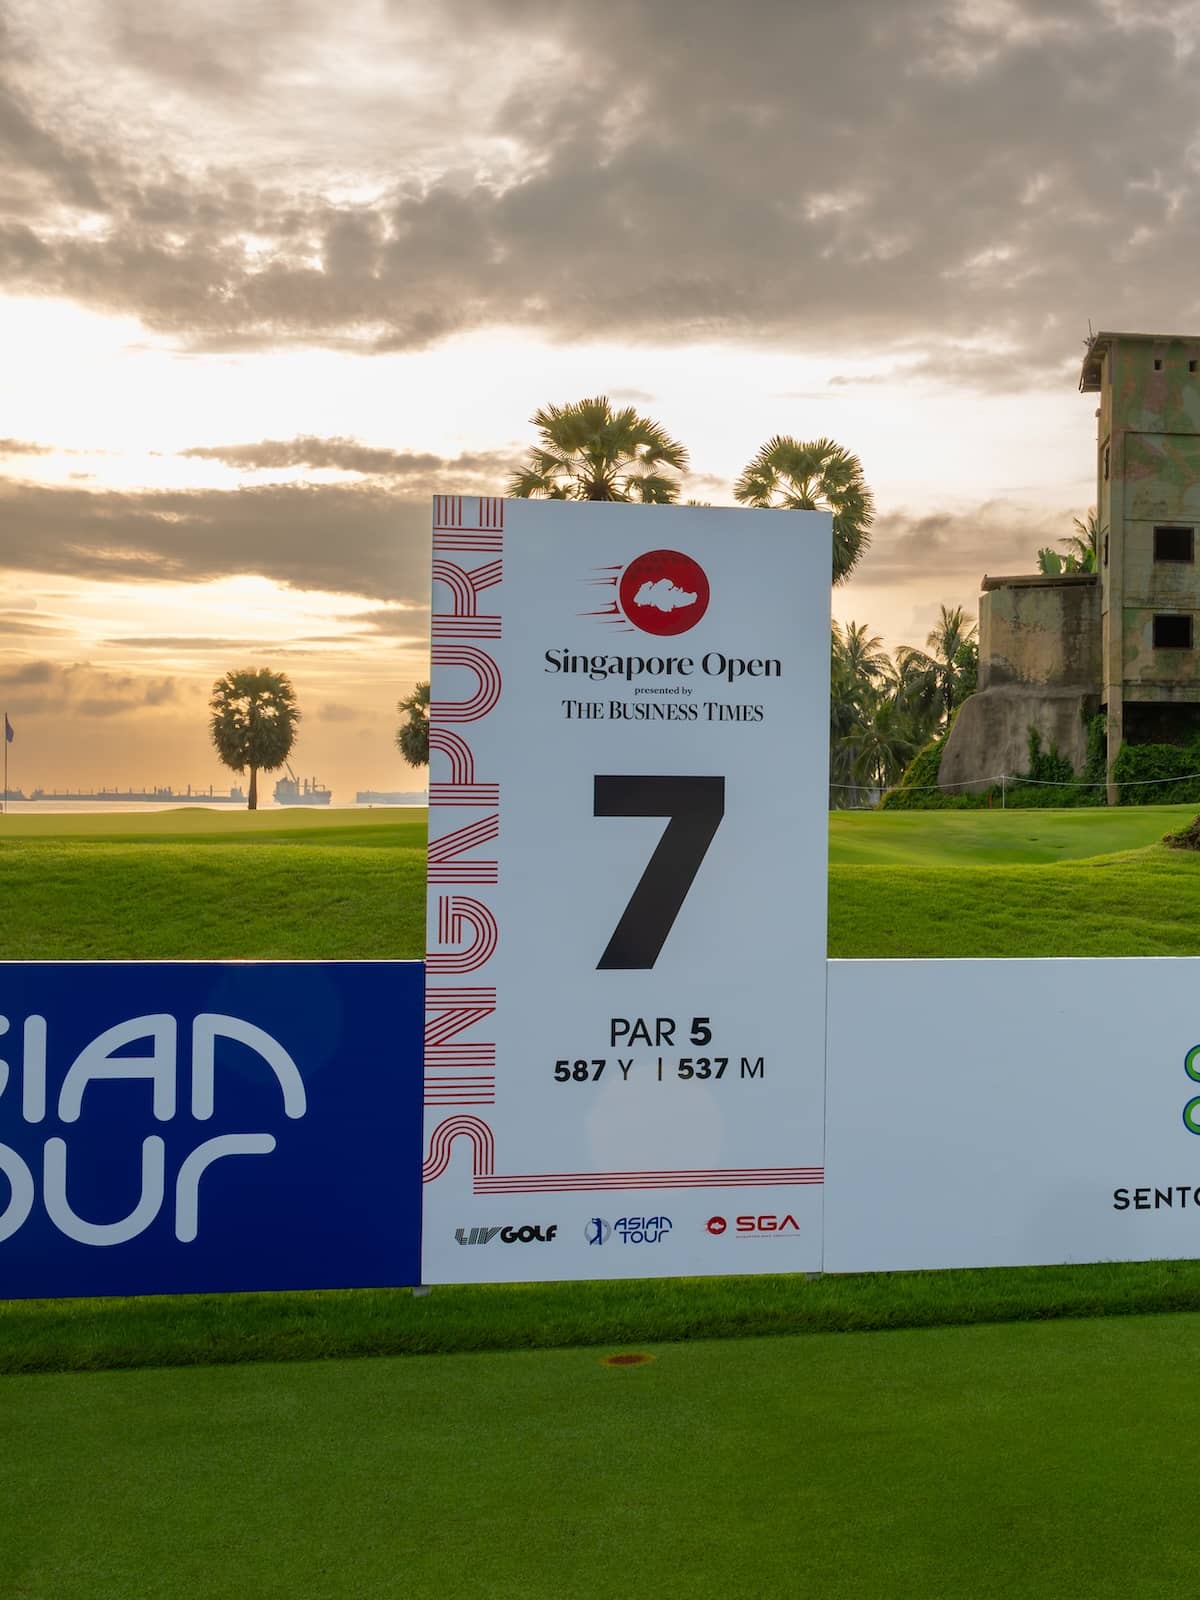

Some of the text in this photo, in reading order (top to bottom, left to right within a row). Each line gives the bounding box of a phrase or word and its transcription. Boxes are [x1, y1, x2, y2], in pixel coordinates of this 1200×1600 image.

[544, 648, 782, 682] Singapore Open
[634, 687, 693, 696] presented by
[561, 700, 764, 722] THE BUSINESS TIMES
[593, 774, 725, 970] 7
[610, 1017, 713, 1047] PAR 5
[0, 1013, 307, 1123] IAN
[553, 1059, 607, 1082] 587
[617, 1059, 634, 1081] Y
[677, 1057, 729, 1080] 537
[741, 1057, 765, 1079] M
[614, 1216, 673, 1230] ASIAN
[736, 1215, 800, 1231] SGA
[619, 1230, 670, 1244] TOUR
